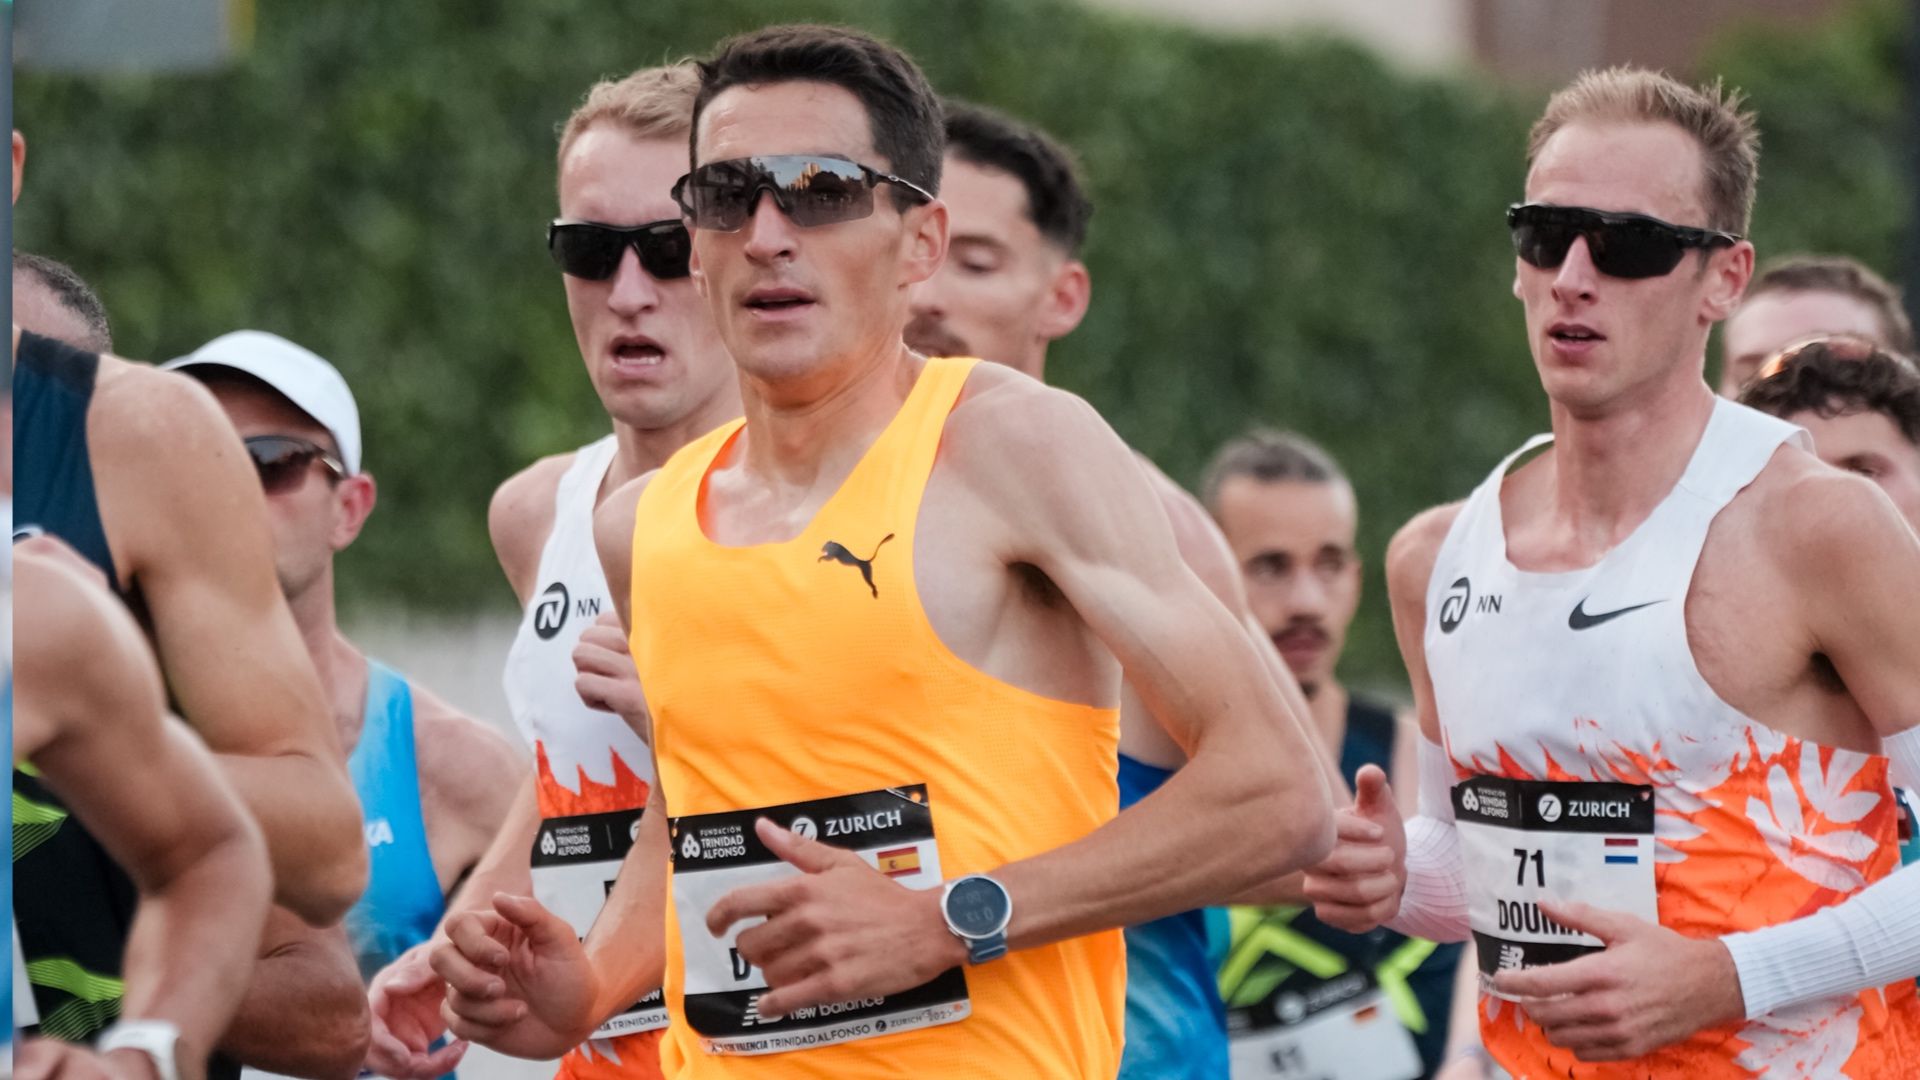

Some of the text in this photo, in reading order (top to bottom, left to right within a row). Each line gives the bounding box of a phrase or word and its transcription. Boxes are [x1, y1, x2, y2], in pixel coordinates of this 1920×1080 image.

[576, 597, 600, 618] NN
[1476, 595, 1502, 614] NN
[1478, 795, 1508, 809] TRINIDAD
[1568, 801, 1630, 818] ZURICH
[1480, 806, 1509, 819] ALFONSO
[825, 809, 902, 837] ZURICH
[555, 834, 590, 846] TRINIDAD
[701, 834, 744, 849] TRINIDAD
[557, 844, 592, 856] ALFONSO
[703, 846, 746, 860] ALFONSO
[1513, 848, 1545, 888] 71
[789, 1006, 817, 1021] new
[818, 995, 885, 1018] balance
[612, 1014, 660, 1029] TRINIDAD
[770, 1033, 816, 1049] TRINIDAD
[816, 1023, 871, 1043] ALFONSO
[890, 1015, 923, 1028] ZURICH
